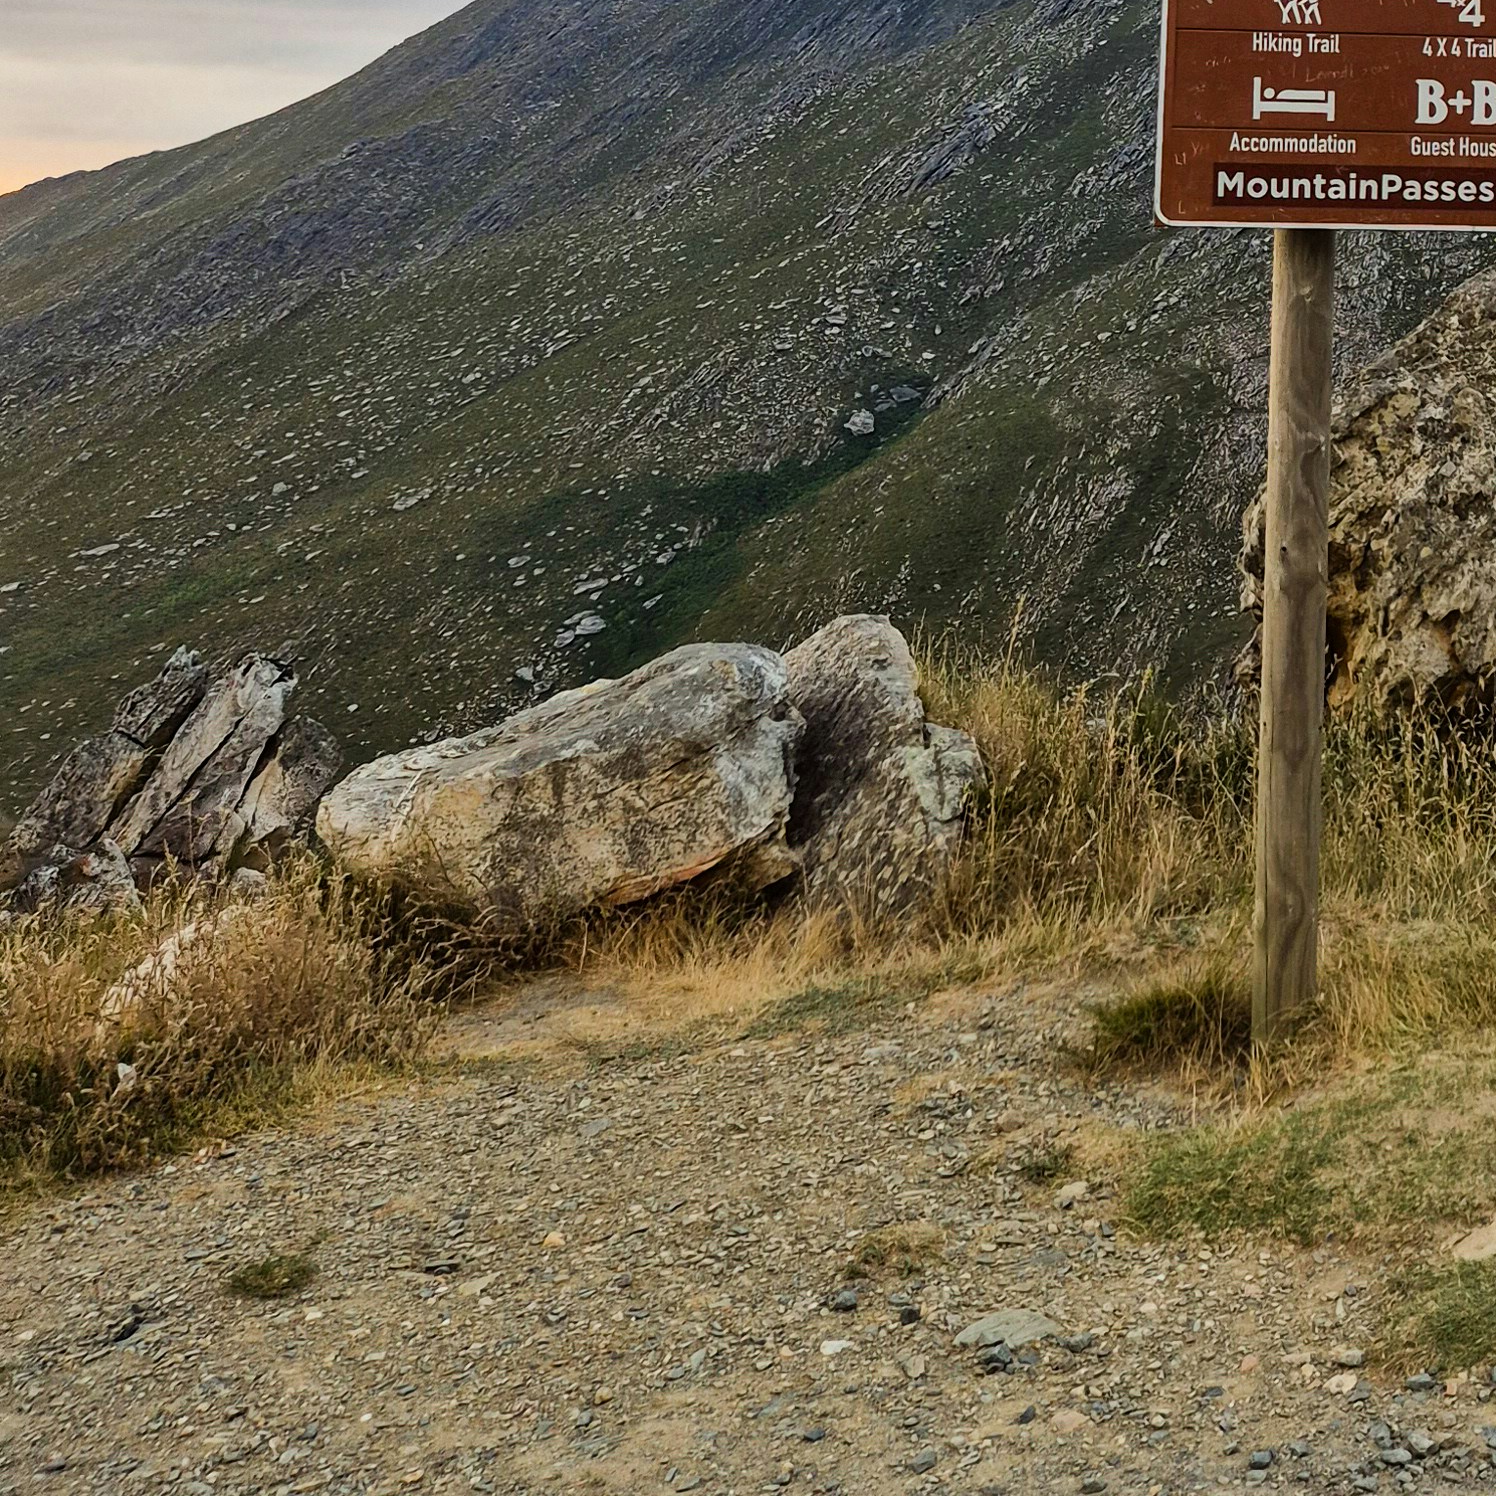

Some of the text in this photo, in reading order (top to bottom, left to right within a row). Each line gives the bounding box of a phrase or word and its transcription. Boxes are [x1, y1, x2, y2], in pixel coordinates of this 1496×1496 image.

[1252, 31, 1340, 58] Hiking Trail
[1422, 37, 1433, 57] 4
[1436, 37, 1447, 57] X
[1450, 37, 1461, 57] 4
[1229, 131, 1356, 154] Accommodation
[1411, 136, 1456, 156] Guest
